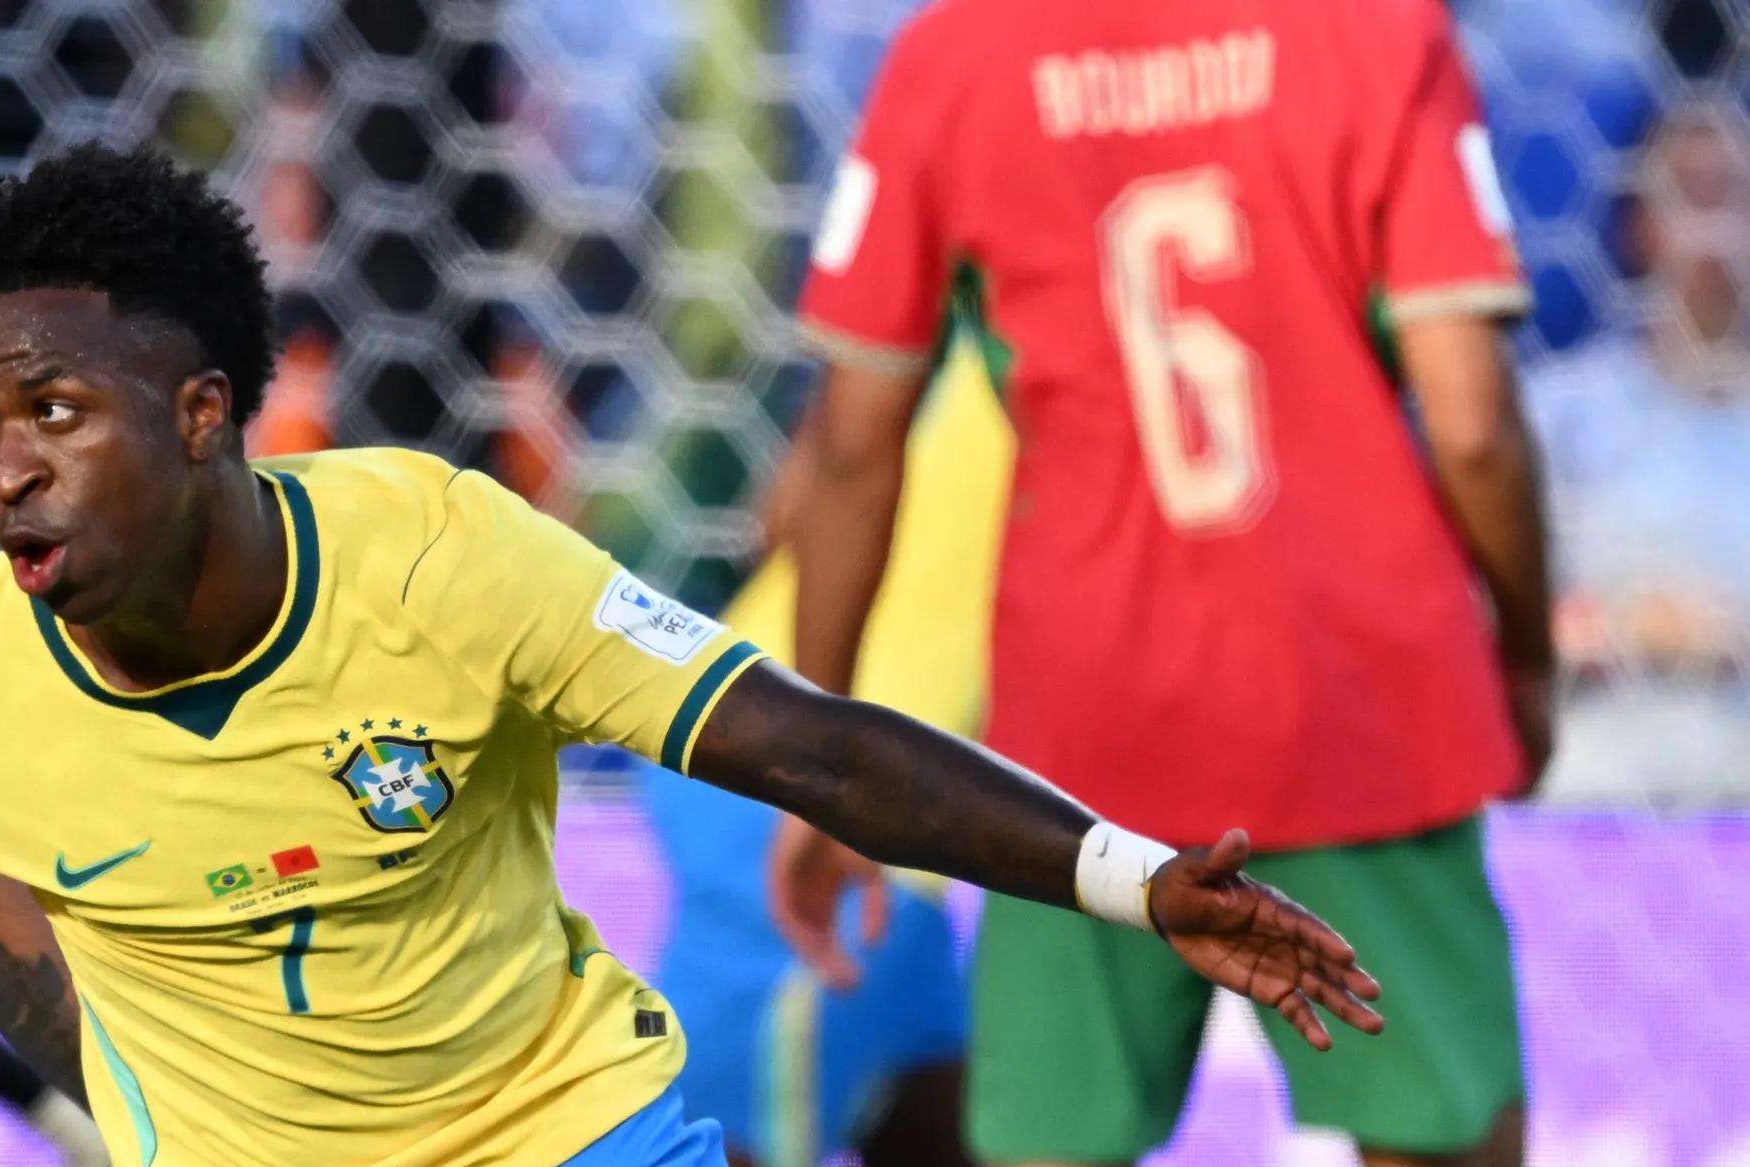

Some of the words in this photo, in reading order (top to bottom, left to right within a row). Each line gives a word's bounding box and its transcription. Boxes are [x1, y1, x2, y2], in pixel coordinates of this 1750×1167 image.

[1095, 163, 1280, 542] 6
[378, 774, 415, 797] CBF
[251, 905, 316, 1014] 7
